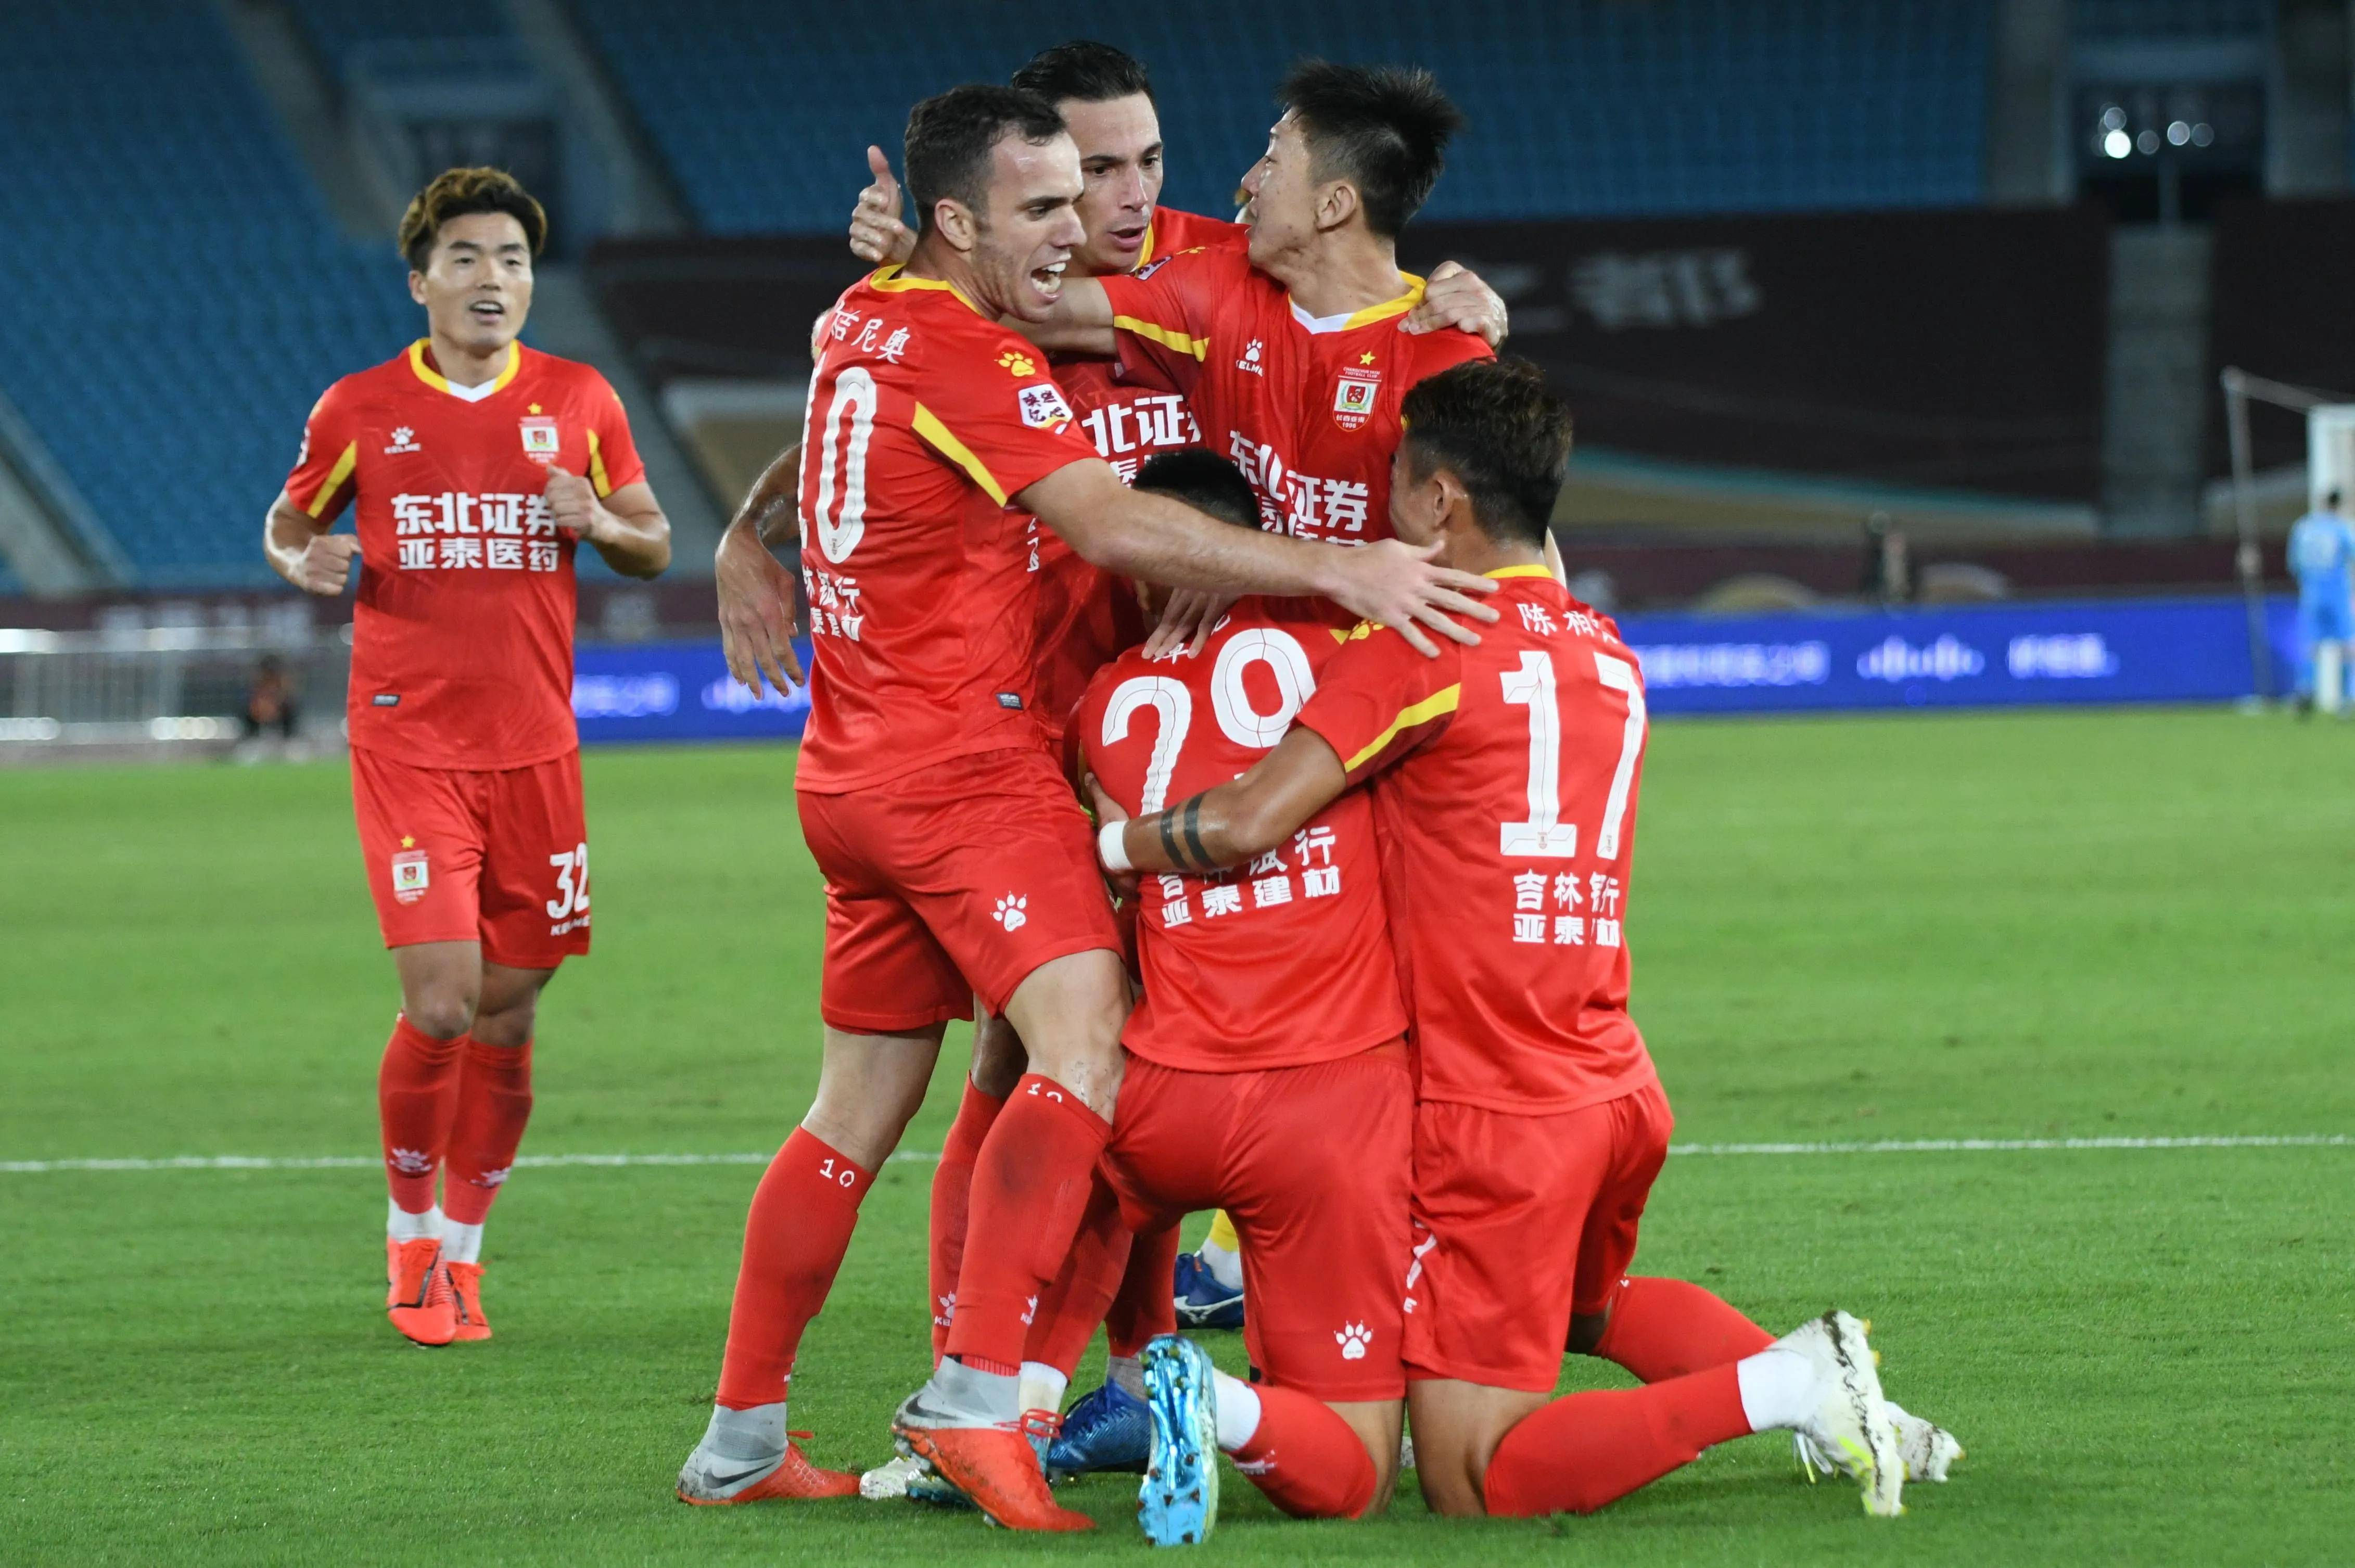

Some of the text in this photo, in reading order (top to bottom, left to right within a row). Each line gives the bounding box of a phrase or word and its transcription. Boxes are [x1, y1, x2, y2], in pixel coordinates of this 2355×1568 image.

[391, 492, 555, 536] 东北证券
[398, 537, 559, 571] 亚泰医药
[1499, 651, 1645, 860] 17
[546, 842, 589, 919] 32
[1162, 865, 1340, 928] 亚泰建材
[1513, 913, 1621, 948] 亚泰材
[819, 1158, 855, 1188] 10
